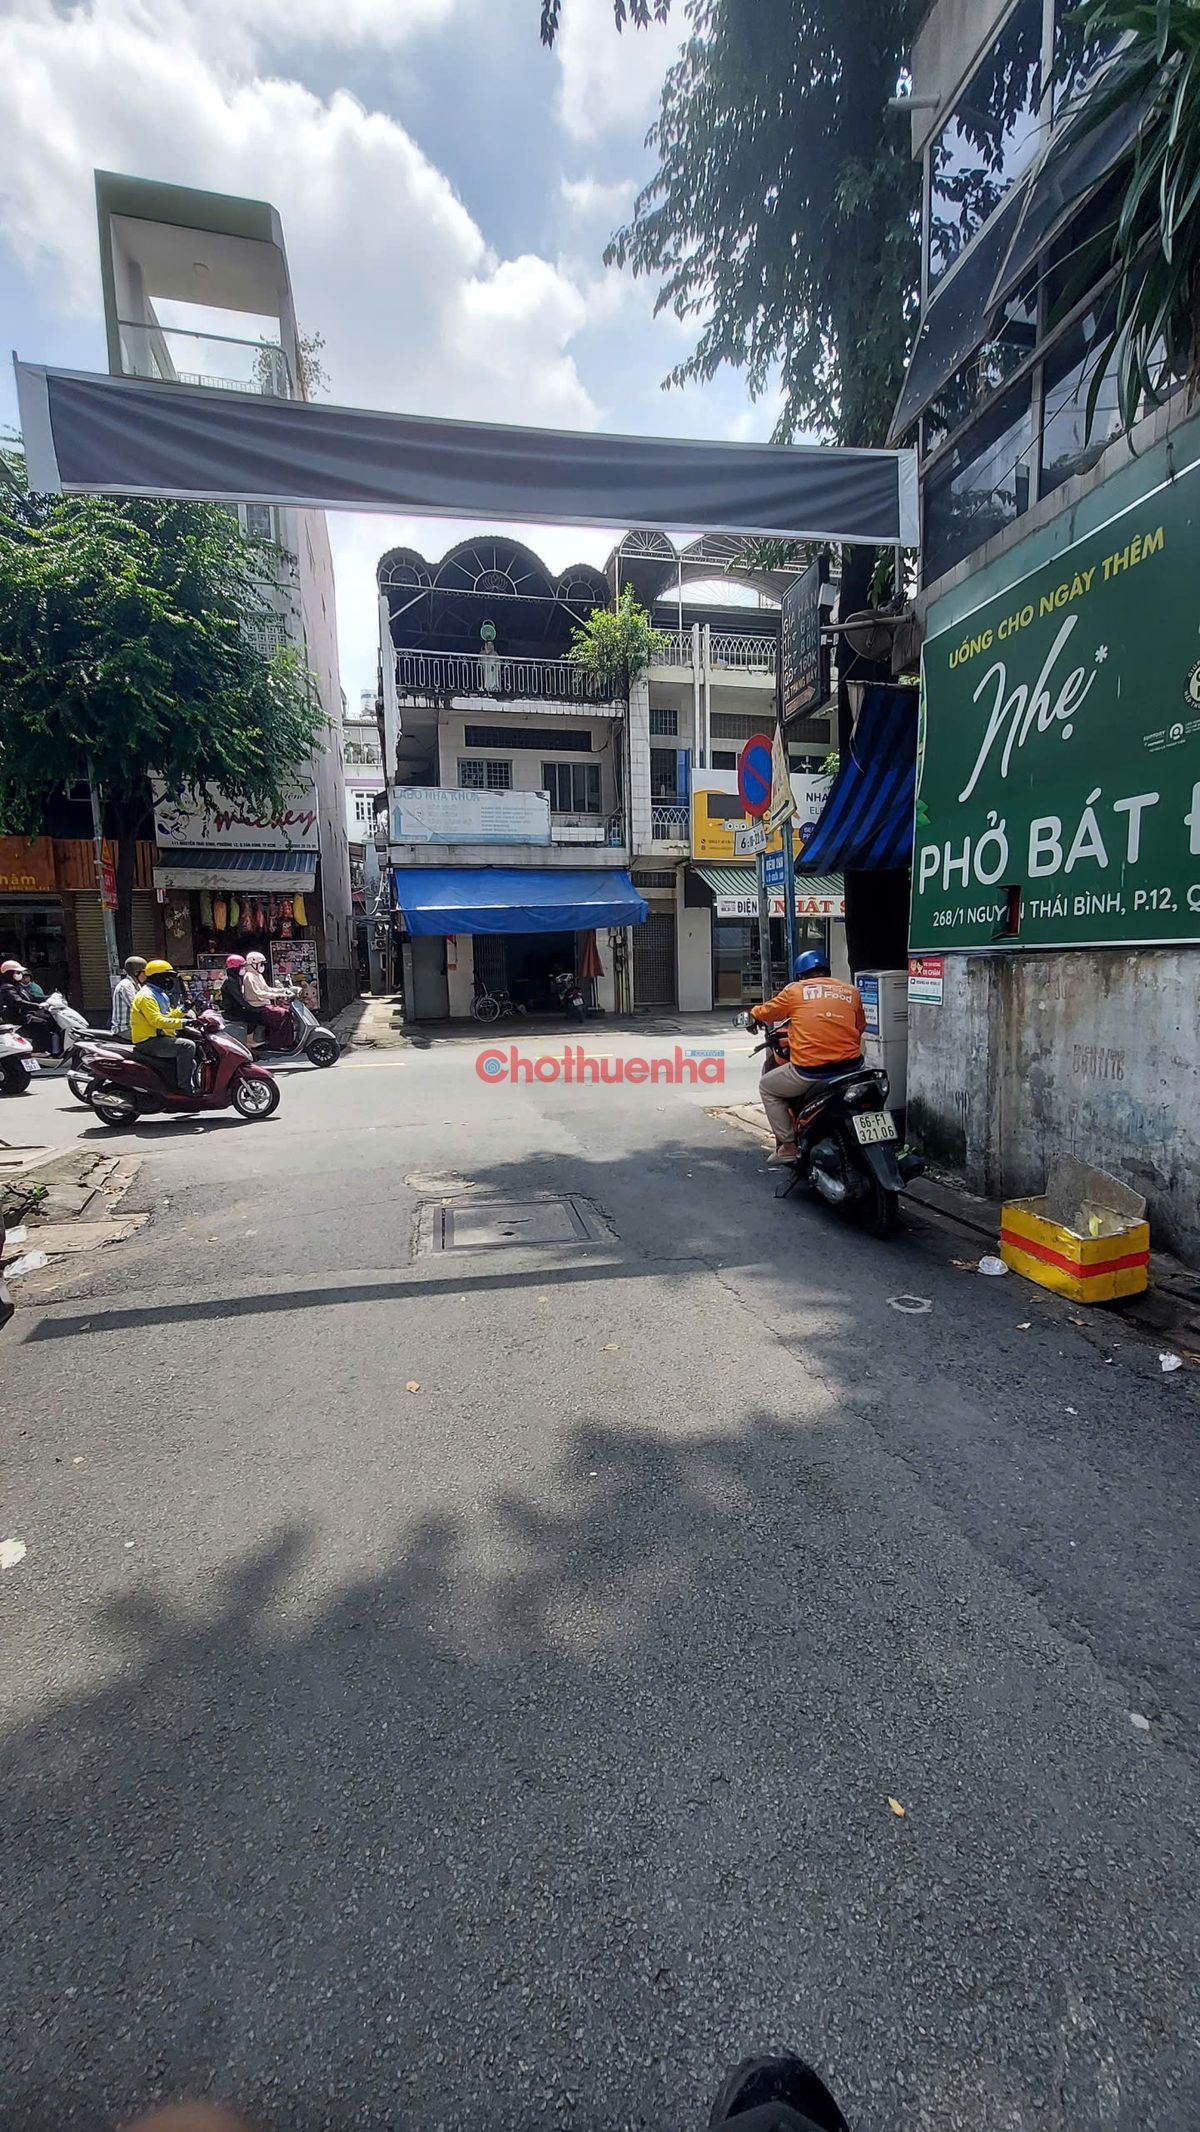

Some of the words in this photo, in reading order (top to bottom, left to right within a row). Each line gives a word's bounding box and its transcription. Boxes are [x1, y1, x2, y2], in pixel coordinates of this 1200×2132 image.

[949, 628, 994, 669] UỐNG
[998, 605, 1034, 641] CHO
[1038, 566, 1096, 618] NGÀY
[1102, 526, 1165, 581] THÊM
[918, 810, 1009, 895] PHỞ
[1027, 787, 1160, 878] BÁT
[737, 897, 758, 916] ĐIỆN
[932, 906, 964, 928] 268/1
[967, 902, 1024, 924] NGUY
[1029, 894, 1068, 918] THÁI
[1074, 890, 1126, 916] BÌNH,
[1134, 887, 1178, 913] P.12,
[824, 991, 852, 1004] Food
[859, 1113, 887, 1129] 66-F1
[859, 1125, 895, 1142] 321.06
